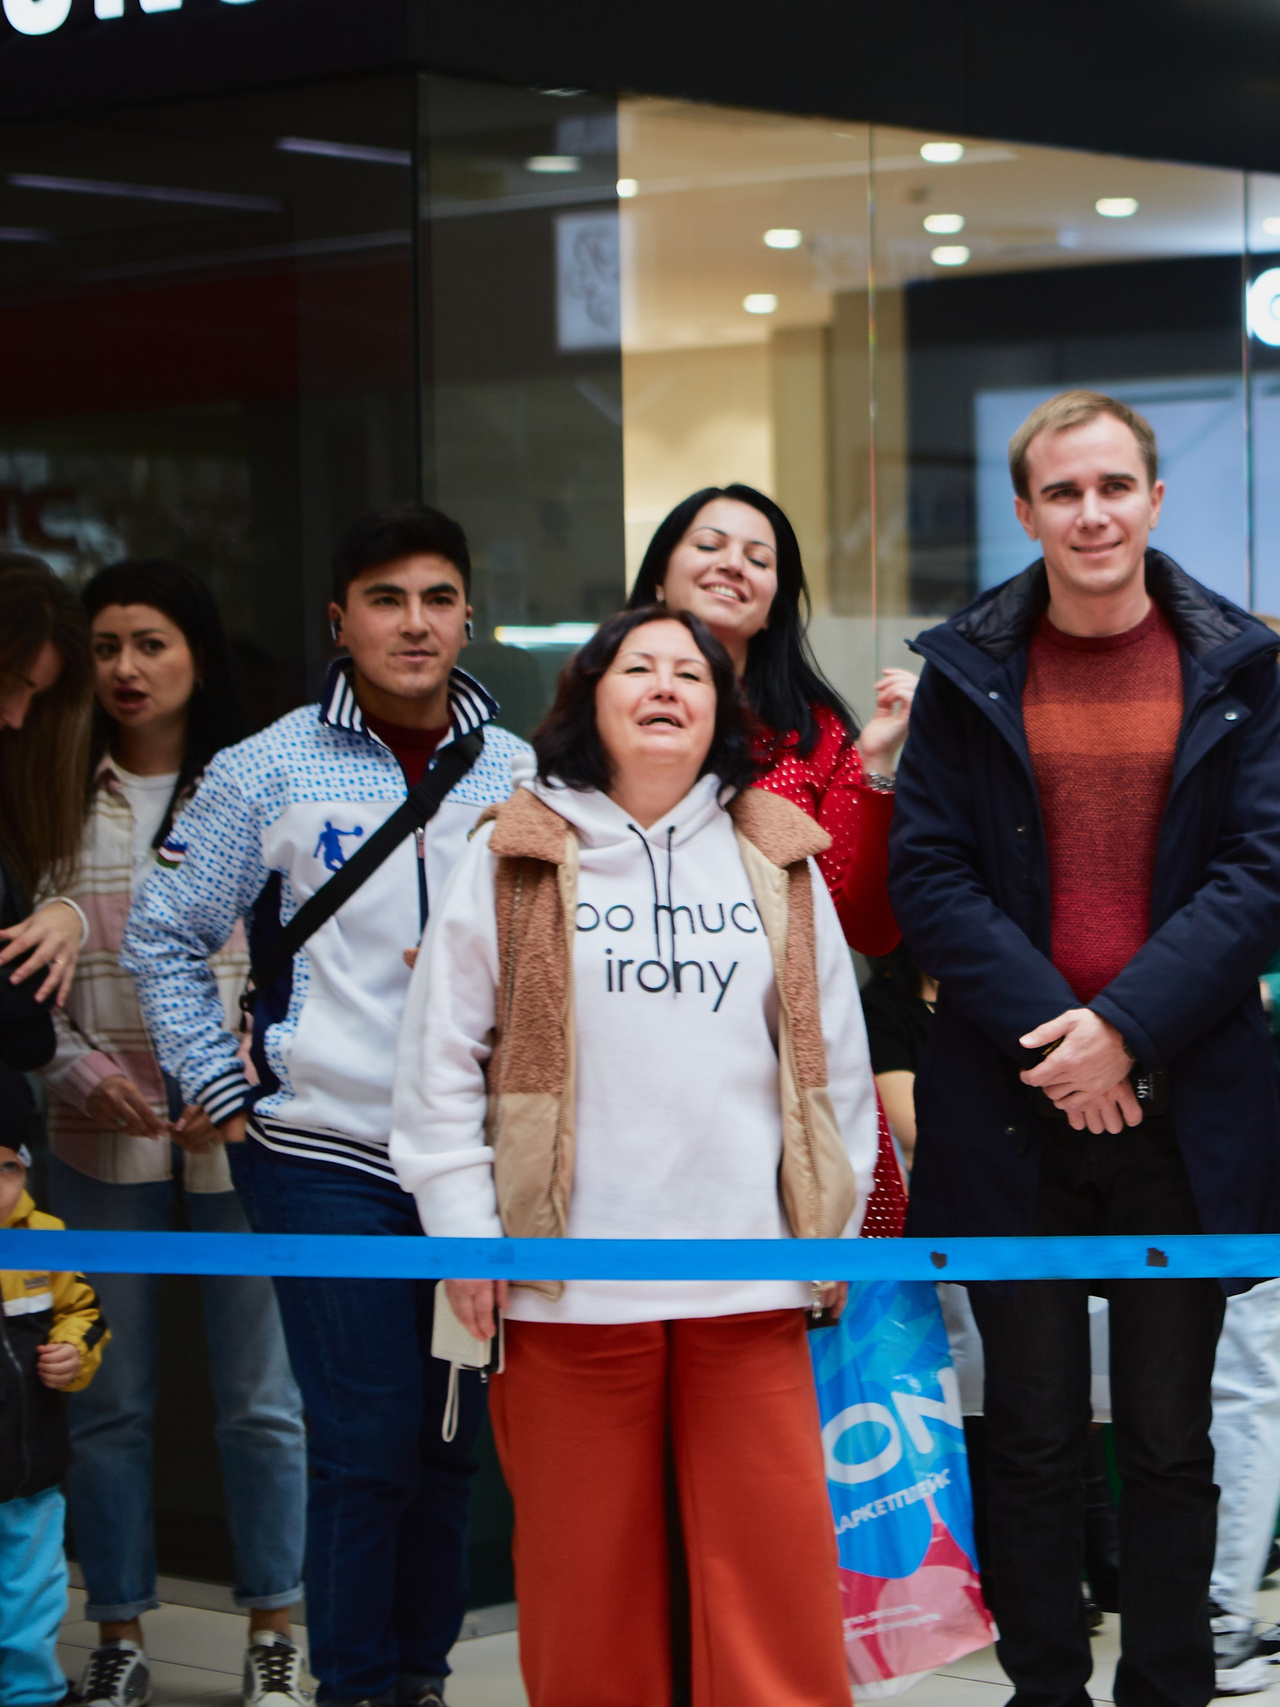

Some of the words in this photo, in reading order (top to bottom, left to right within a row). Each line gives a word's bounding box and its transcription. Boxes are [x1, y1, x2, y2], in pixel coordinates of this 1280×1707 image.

[576, 902, 634, 932] oo
[654, 899, 767, 936] muc
[604, 947, 738, 1013] irony
[834, 1468, 951, 1535] АРКЕТПЛЕЙС
